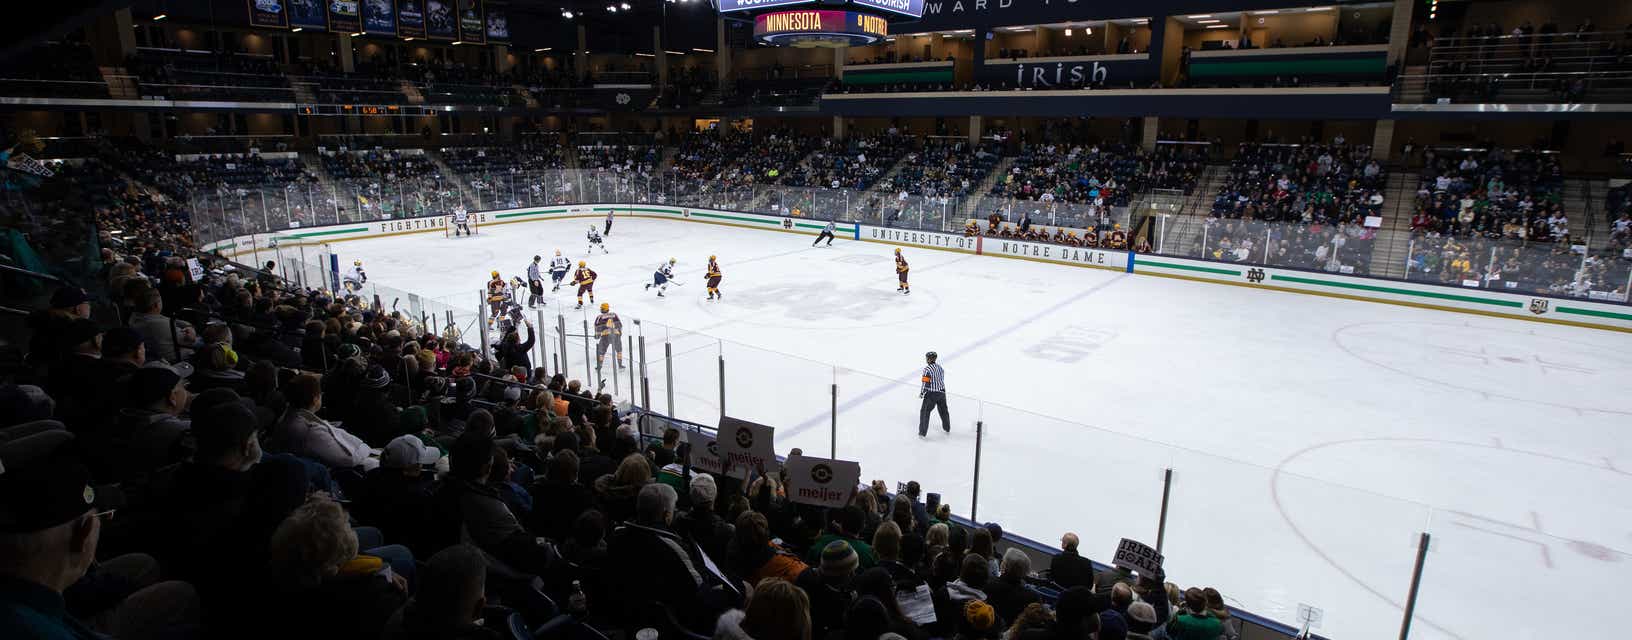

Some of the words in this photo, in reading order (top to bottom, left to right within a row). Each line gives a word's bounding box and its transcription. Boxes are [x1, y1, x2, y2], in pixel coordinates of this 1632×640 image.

[766, 12, 822, 32] MINNESOTA
[381, 218, 444, 233] FIGHTING
[872, 228, 952, 249] UNIVERSITY
[958, 237, 974, 249] OF
[1002, 241, 1051, 258] NOTRE
[1063, 248, 1105, 264] DAME
[799, 487, 842, 501] meijer
[1117, 550, 1155, 573] GOAL
[1120, 540, 1161, 564] IRISH
